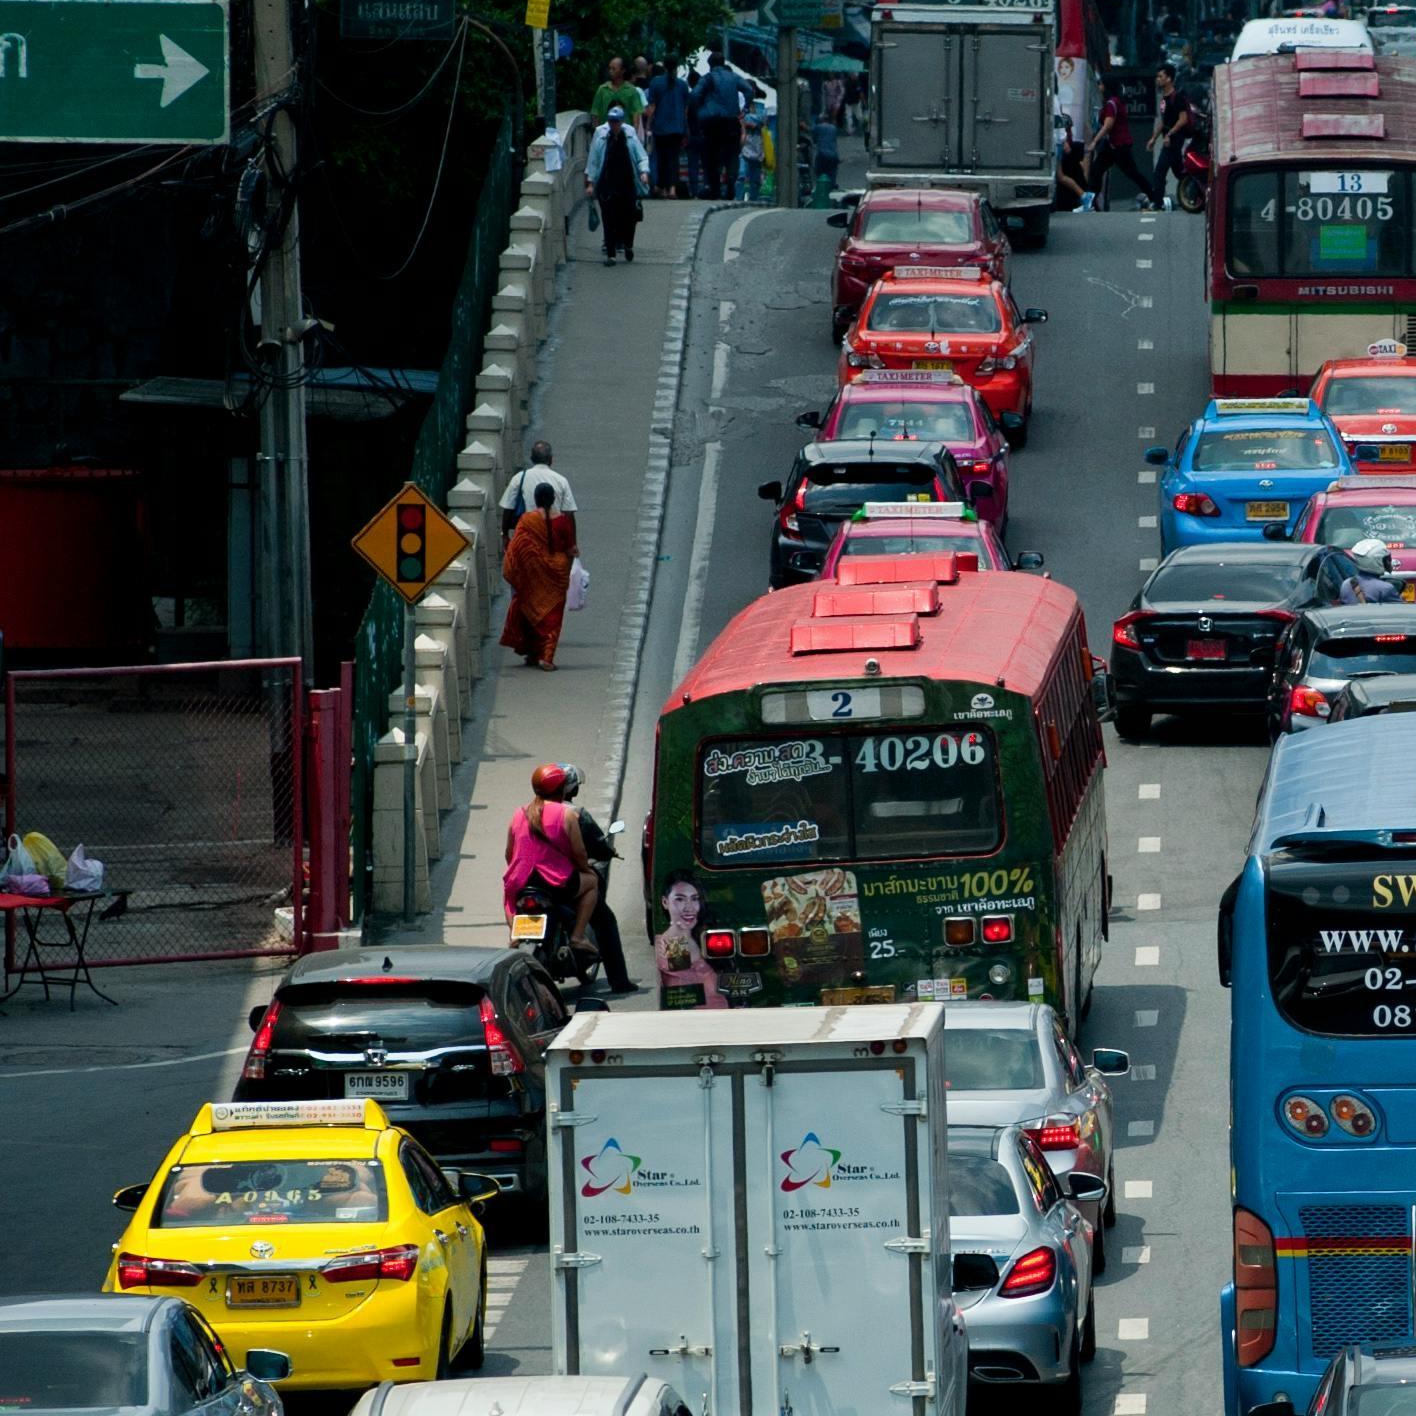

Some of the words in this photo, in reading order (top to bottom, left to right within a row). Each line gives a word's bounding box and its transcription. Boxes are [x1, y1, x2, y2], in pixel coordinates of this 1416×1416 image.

[1337, 174, 1362, 192] 13
[1298, 286, 1394, 296] MITSUBISHI
[1378, 344, 1397, 354] TAXI
[831, 692, 853, 718] 2
[855, 733, 985, 775] 40206
[864, 875, 958, 897] มาส์กมะขาม
[960, 868, 1034, 898] 100%
[916, 890, 960, 904] ธรรมชาติ
[935, 904, 954, 915] จาก
[375, 1075, 405, 1088] 9596
[637, 1169, 668, 1181] Star
[837, 1164, 868, 1174] Star
[632, 1179, 668, 1187] Overseas
[832, 1174, 868, 1182] Overseas
[583, 1214, 660, 1225] 02-108-7433-35
[783, 1207, 860, 1220] 02-108-7433-35
[584, 1225, 700, 1237] www.staroverseas.co.th
[784, 1219, 900, 1232] www.staroverseas.co.th
[261, 1280, 295, 1294] 8737
